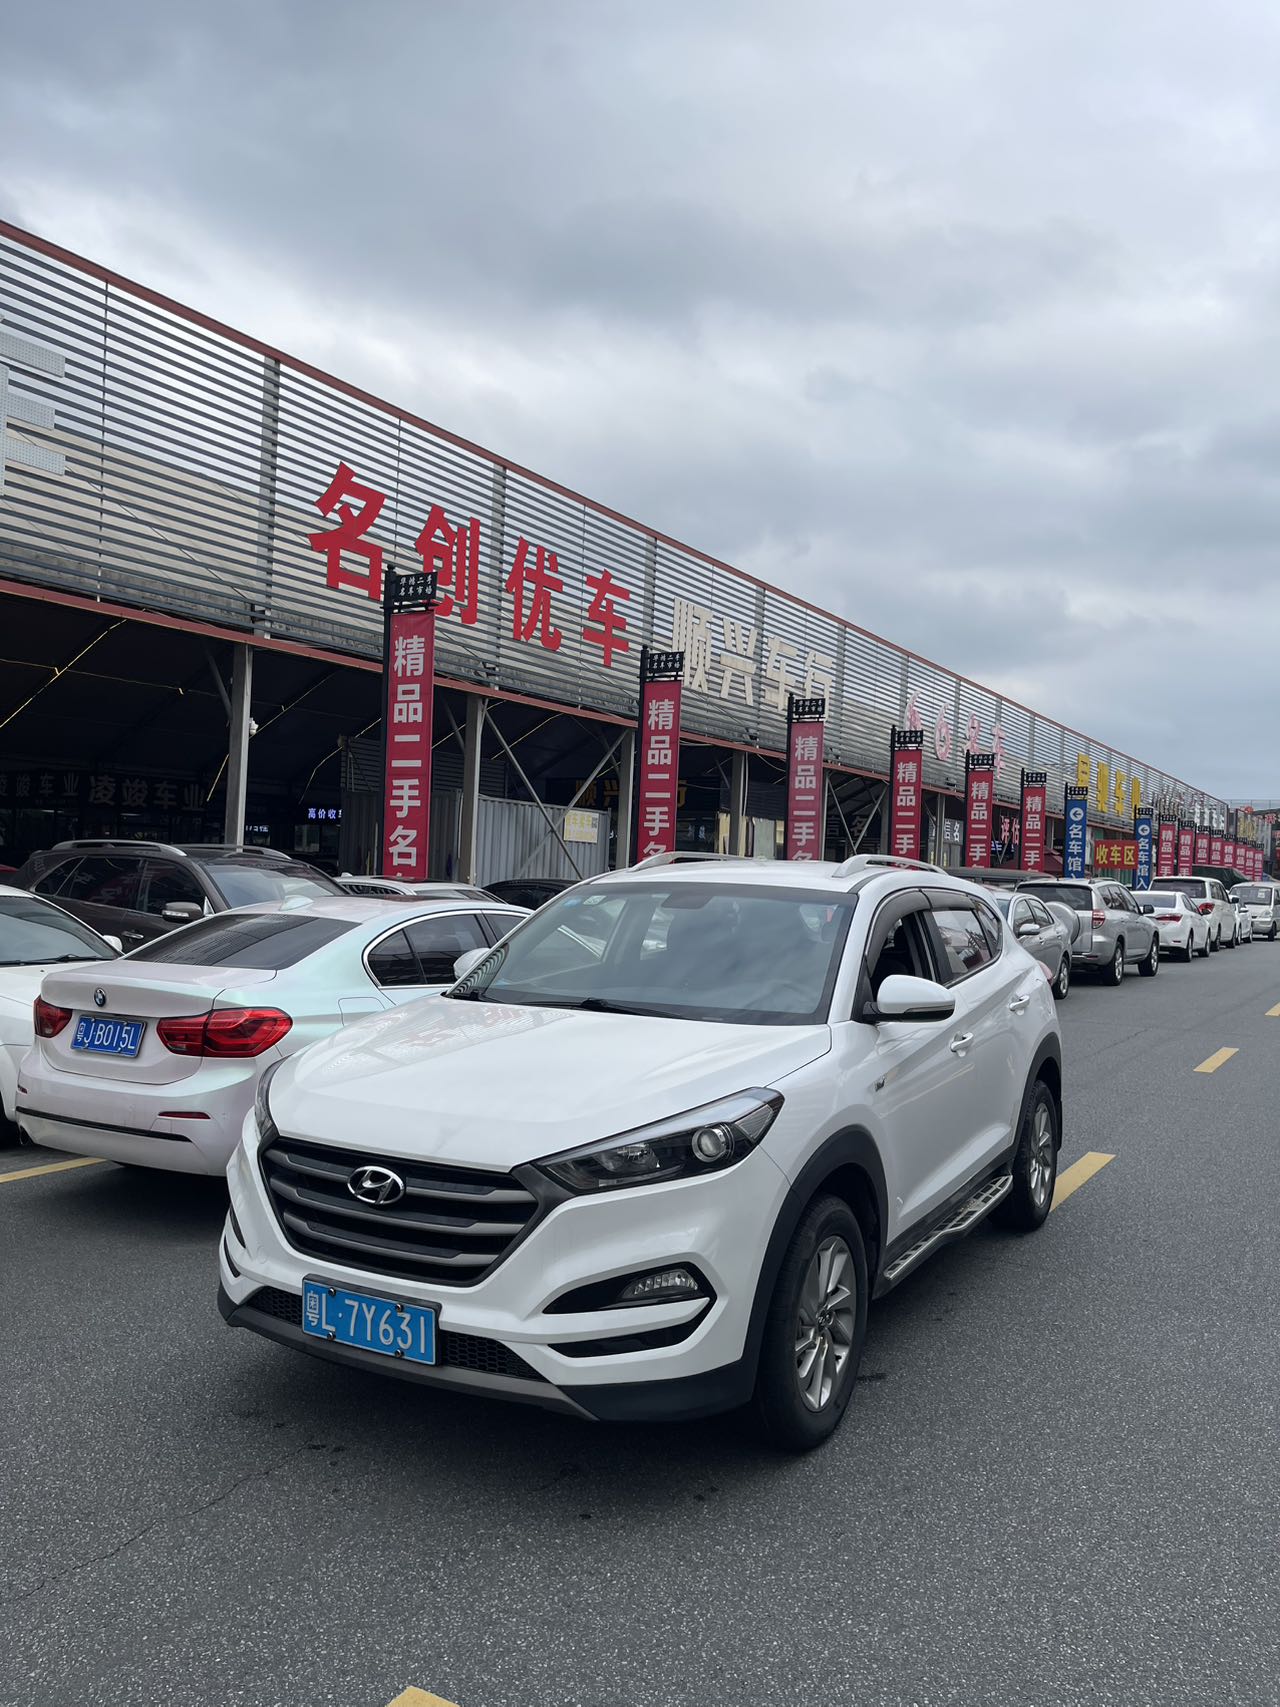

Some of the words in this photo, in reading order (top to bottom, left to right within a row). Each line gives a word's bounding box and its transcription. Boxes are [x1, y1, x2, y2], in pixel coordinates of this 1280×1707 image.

[307, 461, 631, 667] 名创优车
[672, 598, 833, 720] 顺兴车行
[388, 635, 426, 879] 精品二手名
[895, 761, 918, 869] 精品二手
[969, 781, 990, 869] 精品二手
[1024, 796, 1042, 873] 精品二手
[1067, 824, 1083, 879] 名车馆
[1096, 845, 1136, 866] 收车区
